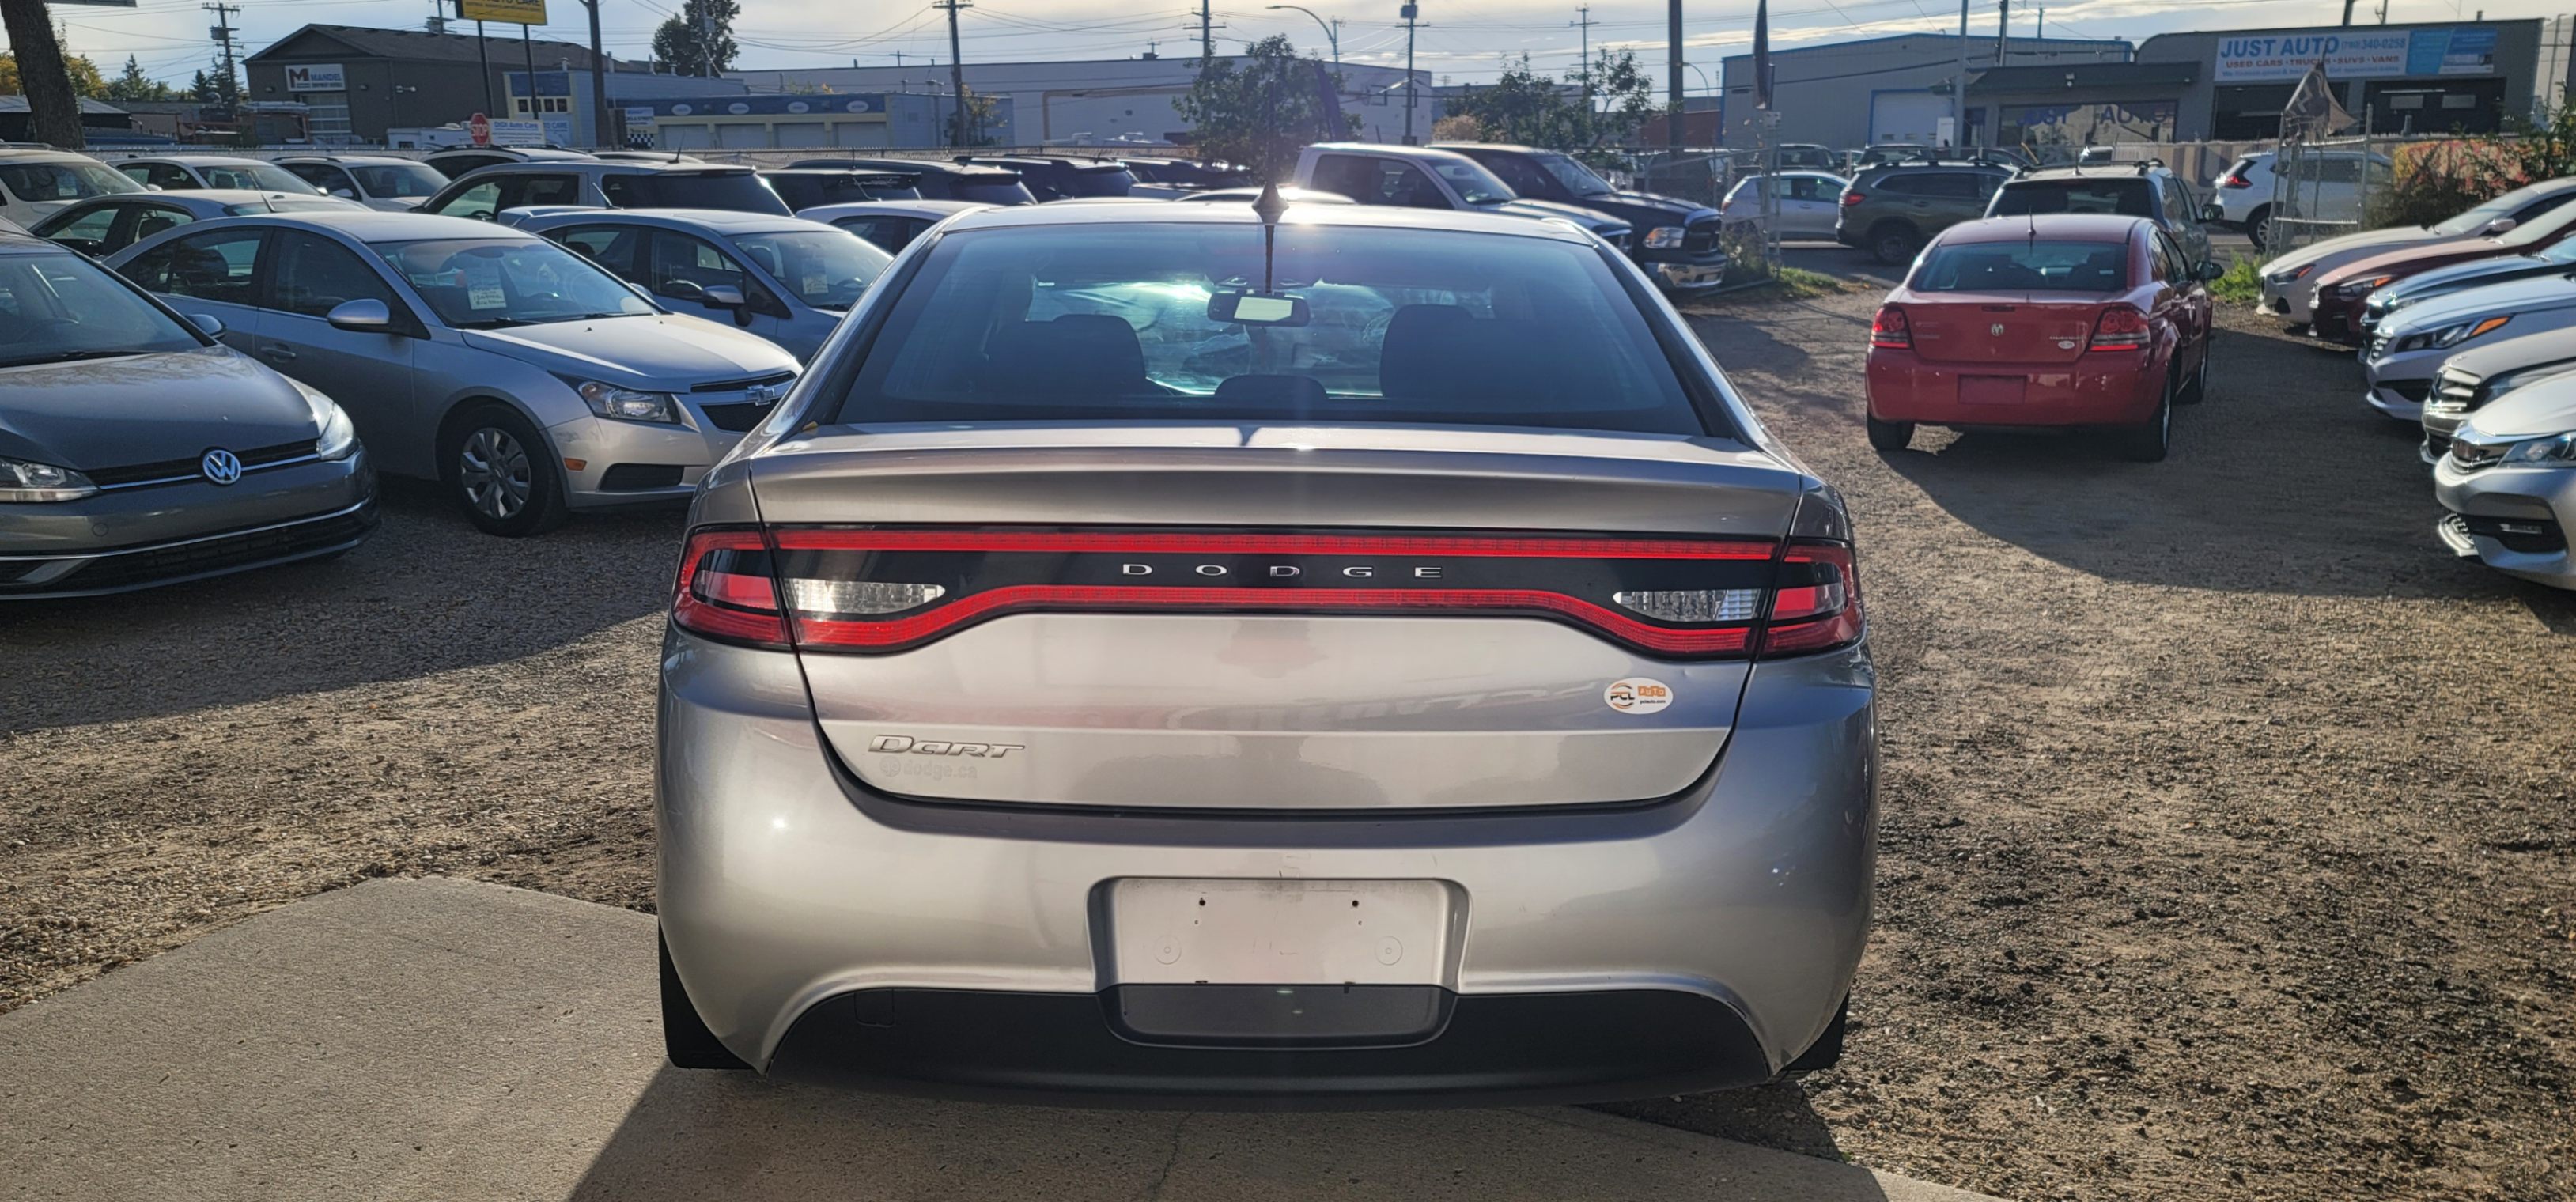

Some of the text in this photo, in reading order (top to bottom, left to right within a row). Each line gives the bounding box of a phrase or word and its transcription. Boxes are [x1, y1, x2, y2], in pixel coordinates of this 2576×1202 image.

[2220, 39, 2276, 58] JUST
[2280, 36, 2340, 56] AUTO
[2338, 55, 2365, 64] SUVS
[471, 123, 489, 136] STOP
[1122, 563, 1443, 579] DODGE
[1639, 687, 1665, 696] AUTO
